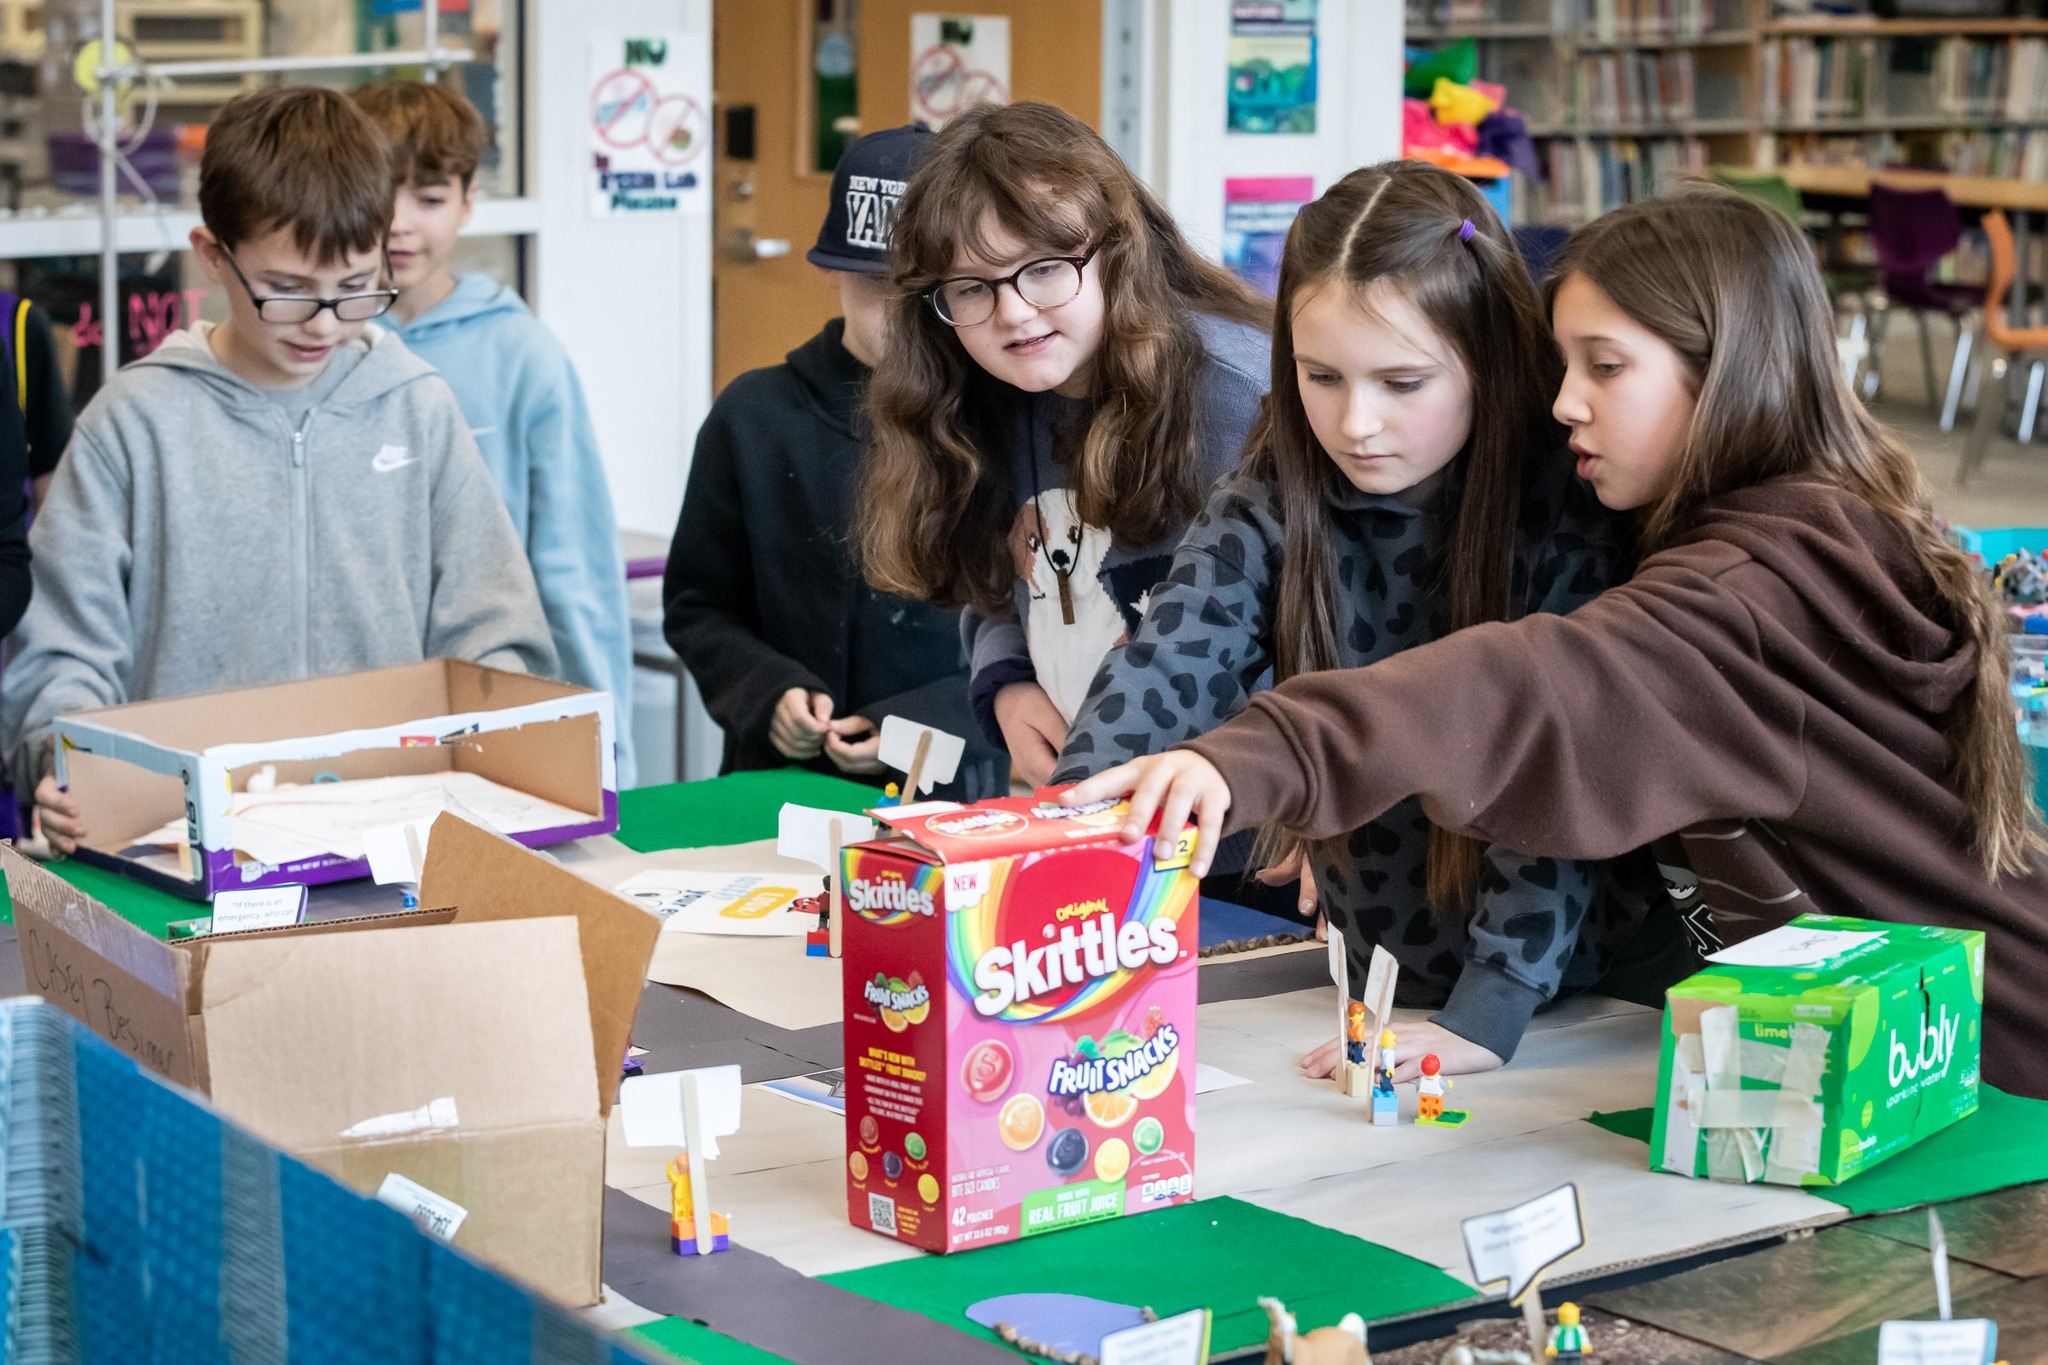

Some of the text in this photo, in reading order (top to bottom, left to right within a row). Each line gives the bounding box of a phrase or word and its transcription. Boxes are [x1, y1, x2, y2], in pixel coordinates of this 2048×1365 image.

[849, 175, 878, 192] NEW
[849, 876, 935, 917] Skittles
[953, 875, 977, 892] NEW
[974, 912, 1179, 1016] Skittles
[1049, 1025, 1179, 1095] FRUIT SNACKS
[1888, 1003, 1961, 1088] bubly
[952, 1206, 967, 1227] 42
[1028, 1205, 1056, 1226] REAL
[1057, 1198, 1088, 1219] FRUIT
[1089, 1191, 1119, 1213] JUICE
